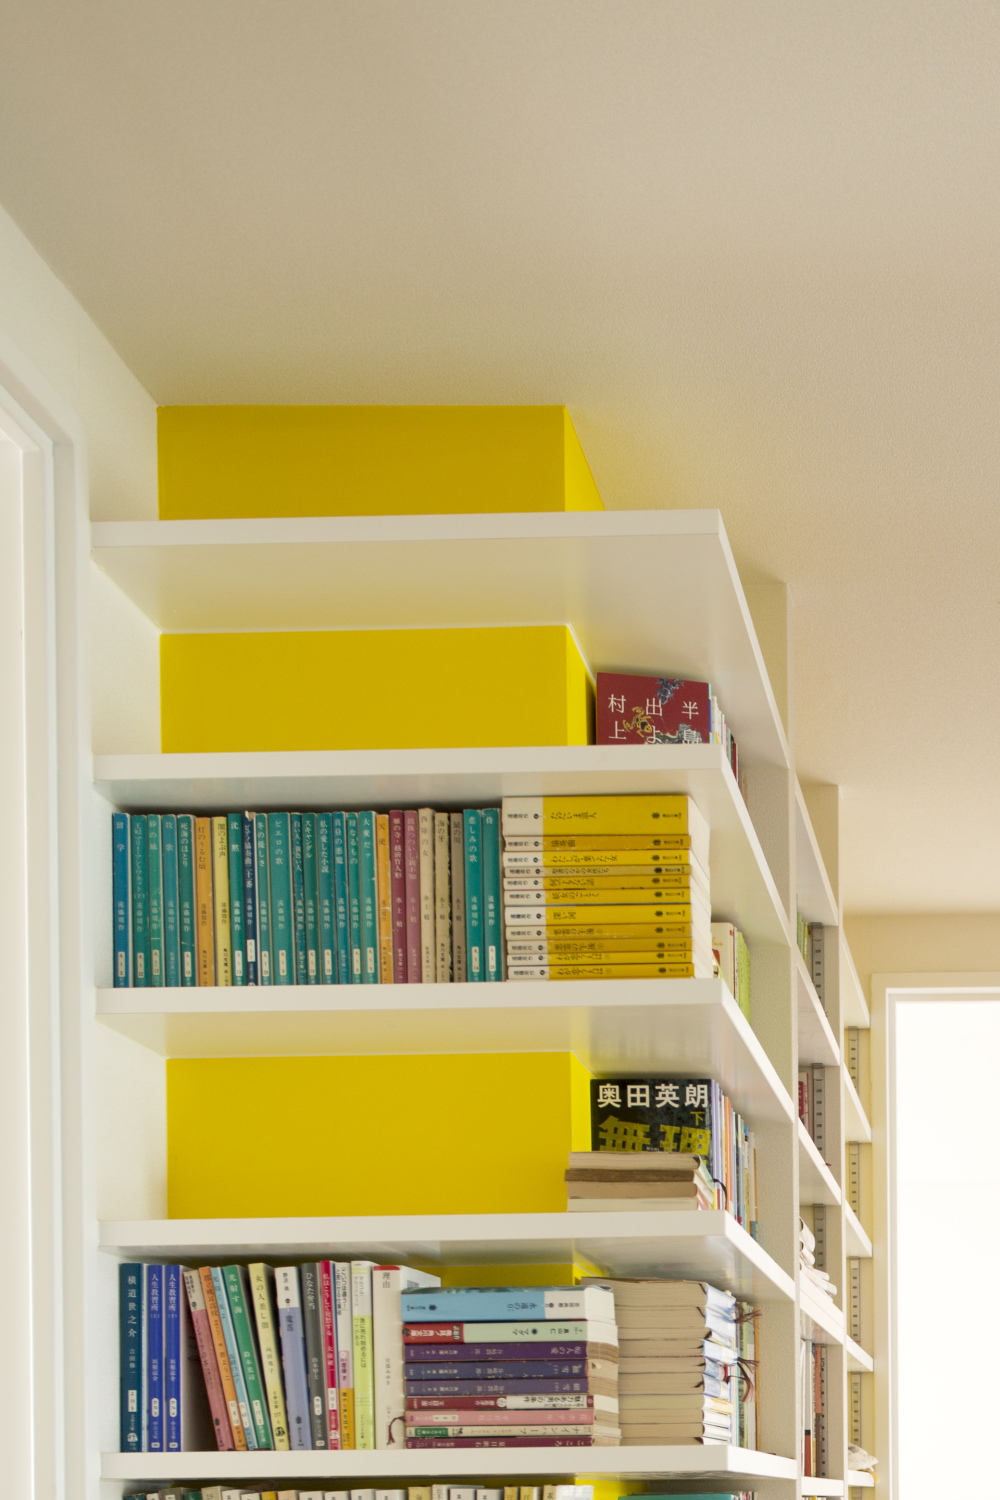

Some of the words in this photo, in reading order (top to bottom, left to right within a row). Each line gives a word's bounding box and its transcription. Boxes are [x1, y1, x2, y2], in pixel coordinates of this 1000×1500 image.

[597, 1083, 709, 1108] 奥田英朗
[382, 1272, 391, 1288] 理由
[127, 1275, 137, 1337] 横道世之介
